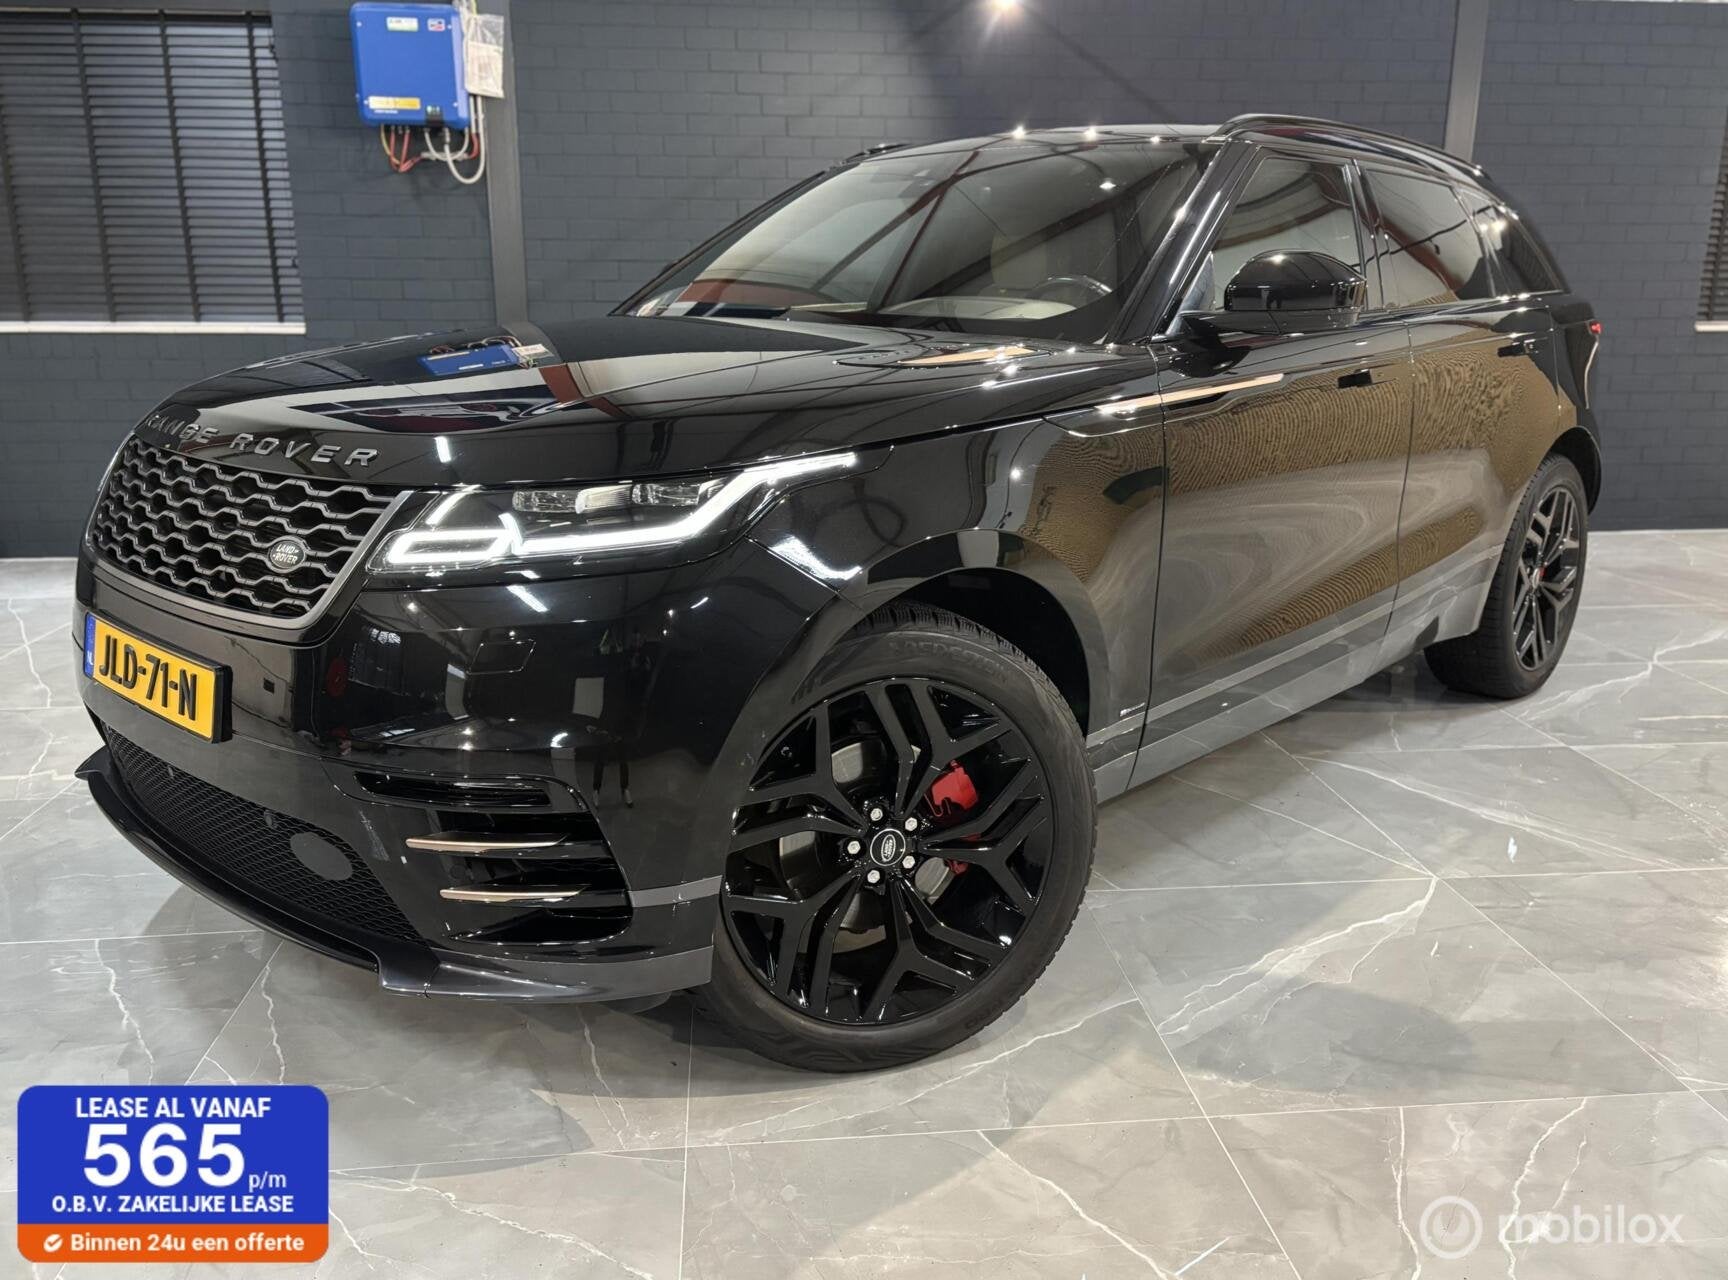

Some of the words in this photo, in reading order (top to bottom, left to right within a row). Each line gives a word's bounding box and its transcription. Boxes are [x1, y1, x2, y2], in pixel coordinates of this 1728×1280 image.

[229, 432, 379, 467] ROVER
[274, 552, 299, 565] ROVER
[276, 543, 296, 554] LAND
[98, 634, 198, 722] JLD-71-N
